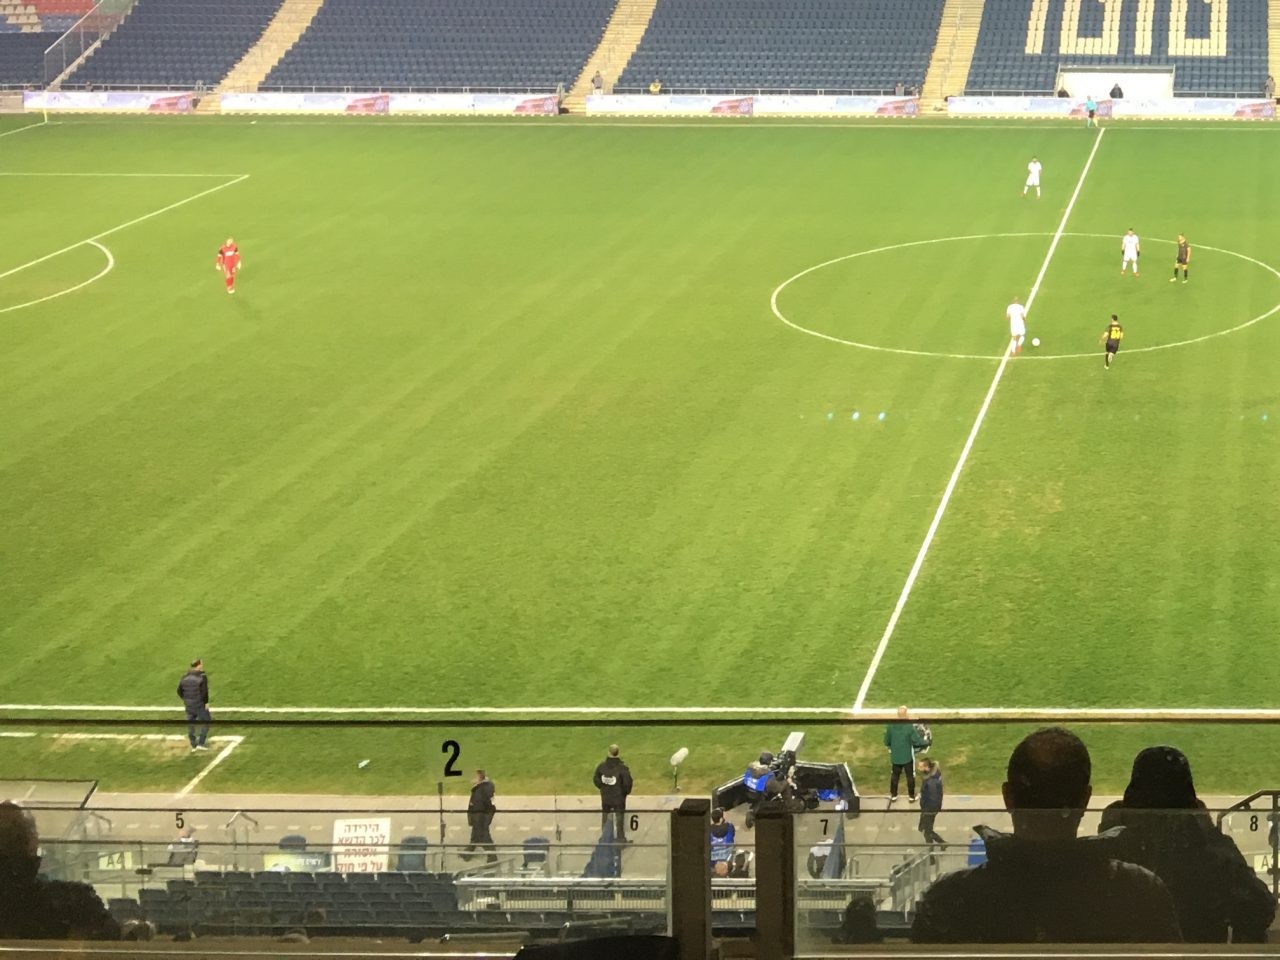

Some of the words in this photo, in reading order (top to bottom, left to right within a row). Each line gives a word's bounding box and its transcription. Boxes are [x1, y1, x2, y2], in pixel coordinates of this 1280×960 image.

[441, 738, 463, 778] 2
[175, 812, 185, 829] 5
[343, 823, 380, 833] הירידה
[630, 814, 639, 832] 6
[819, 819, 829, 837] 7
[1250, 814, 1258, 832] 8
